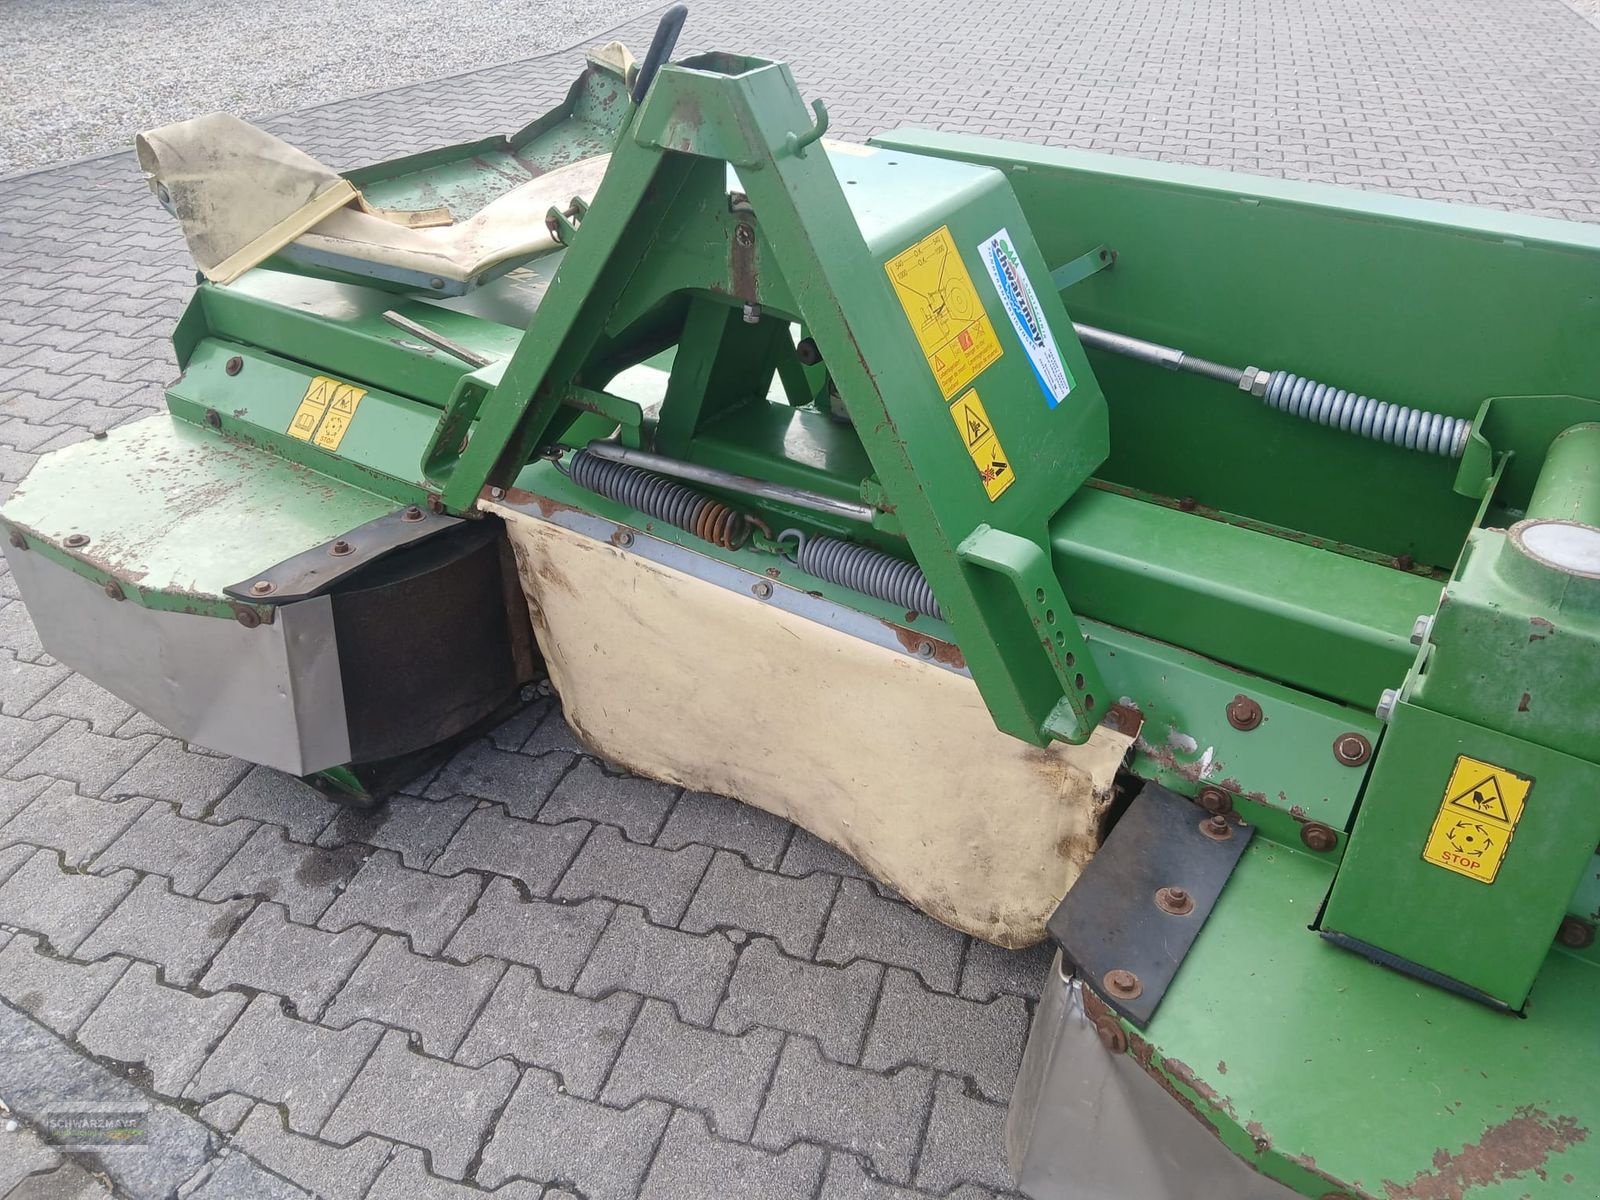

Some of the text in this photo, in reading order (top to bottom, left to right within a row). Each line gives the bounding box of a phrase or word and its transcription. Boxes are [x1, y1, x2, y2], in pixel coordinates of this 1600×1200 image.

[991, 238, 1046, 348] schwarzmayr
[319, 436, 335, 444] STOP
[1441, 850, 1481, 870] STOP
